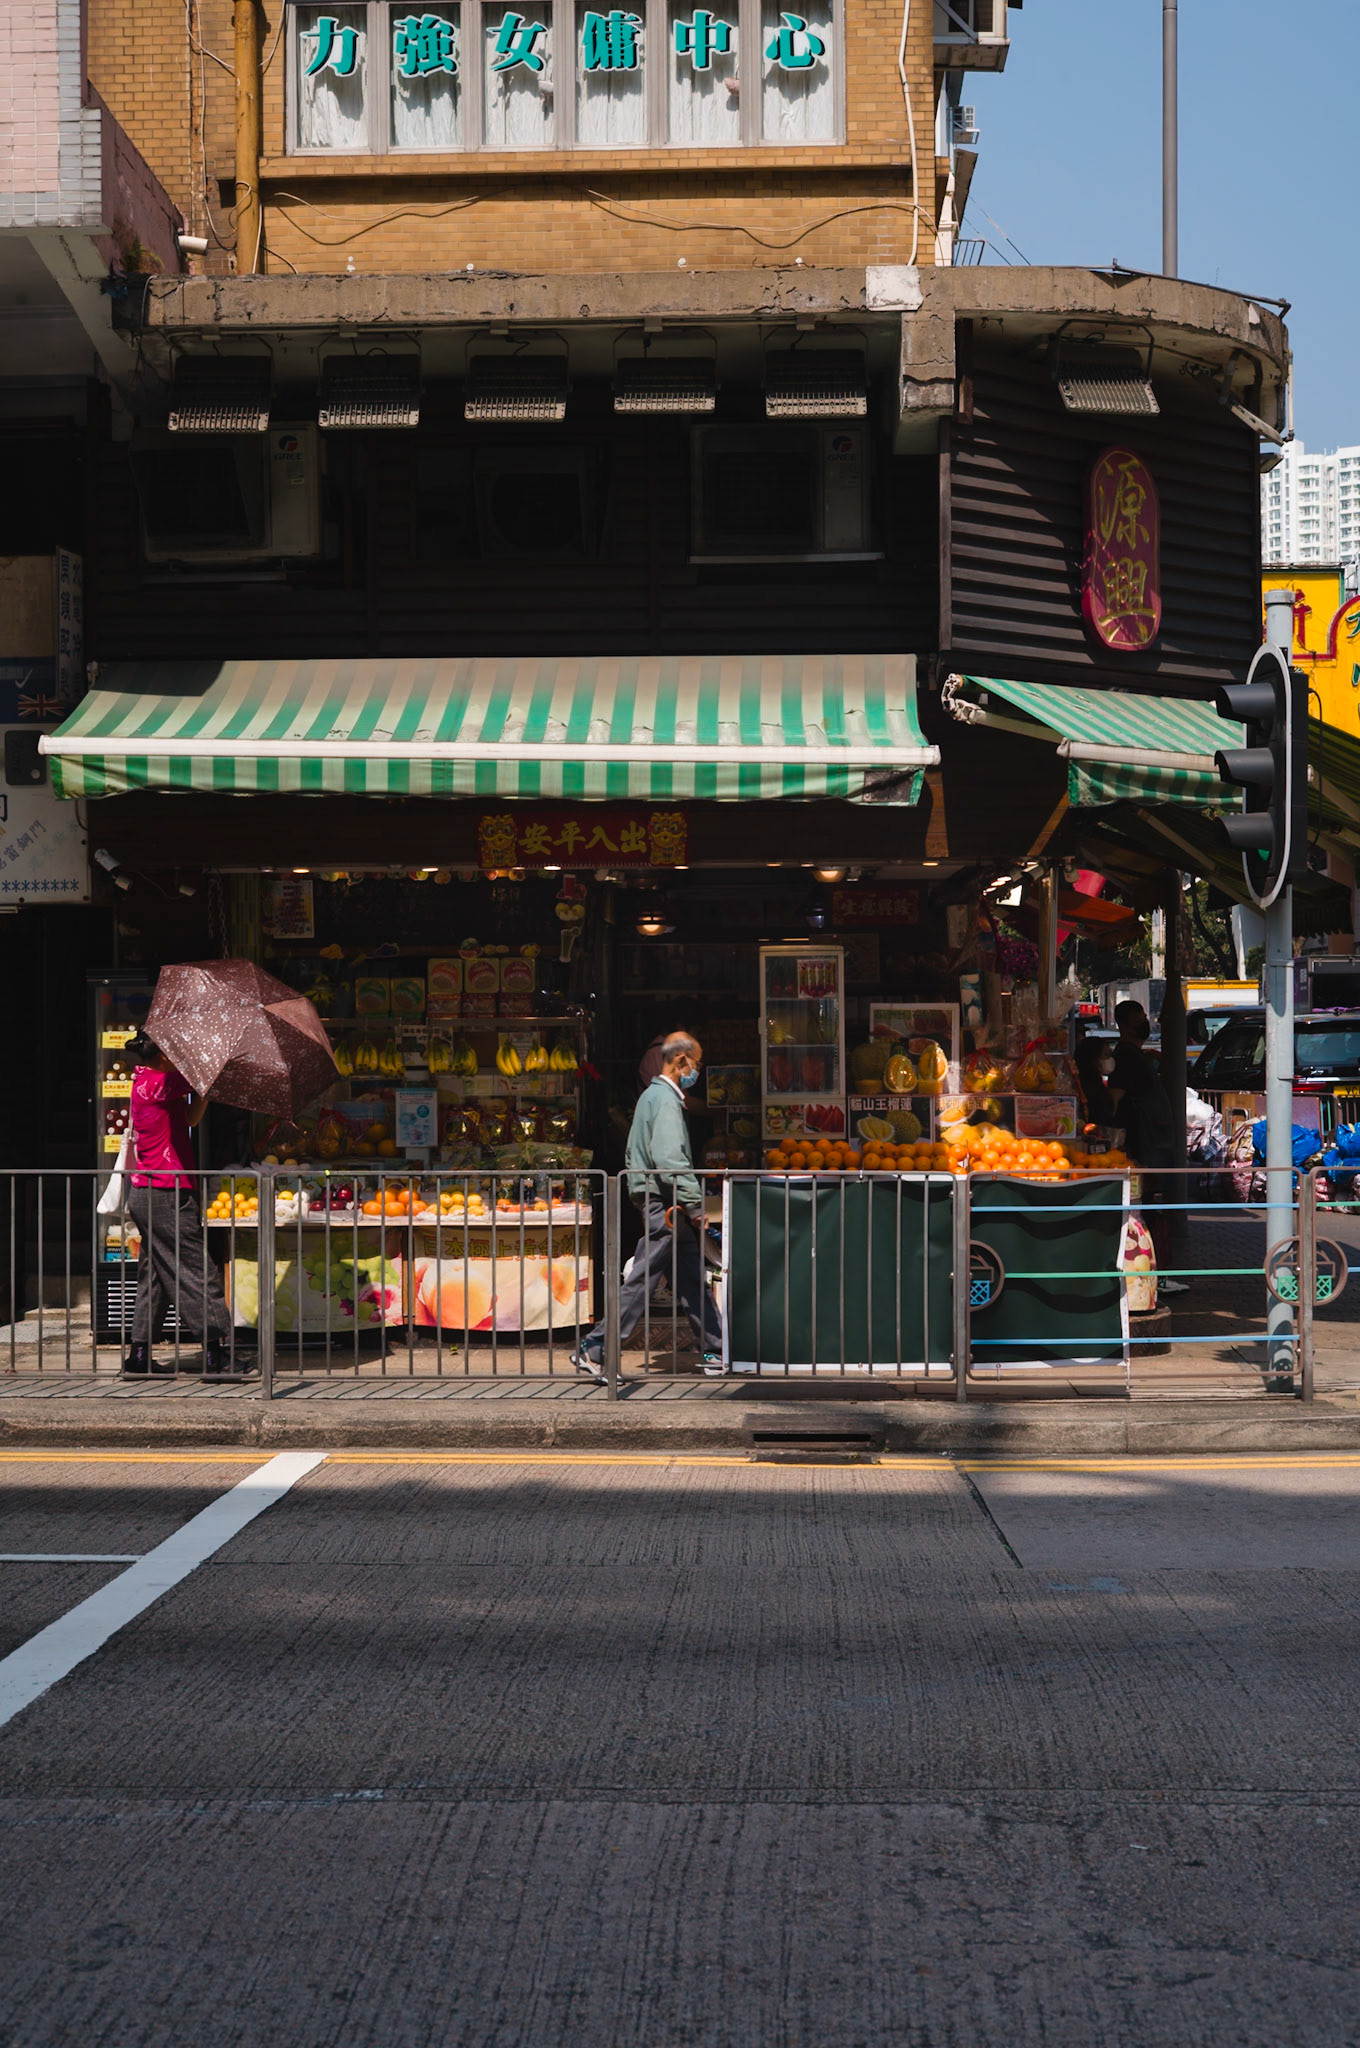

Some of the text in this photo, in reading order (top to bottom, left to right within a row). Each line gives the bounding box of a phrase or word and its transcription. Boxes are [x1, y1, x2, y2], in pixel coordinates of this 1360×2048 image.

[300, 9, 826, 78] 力強女傭中心
